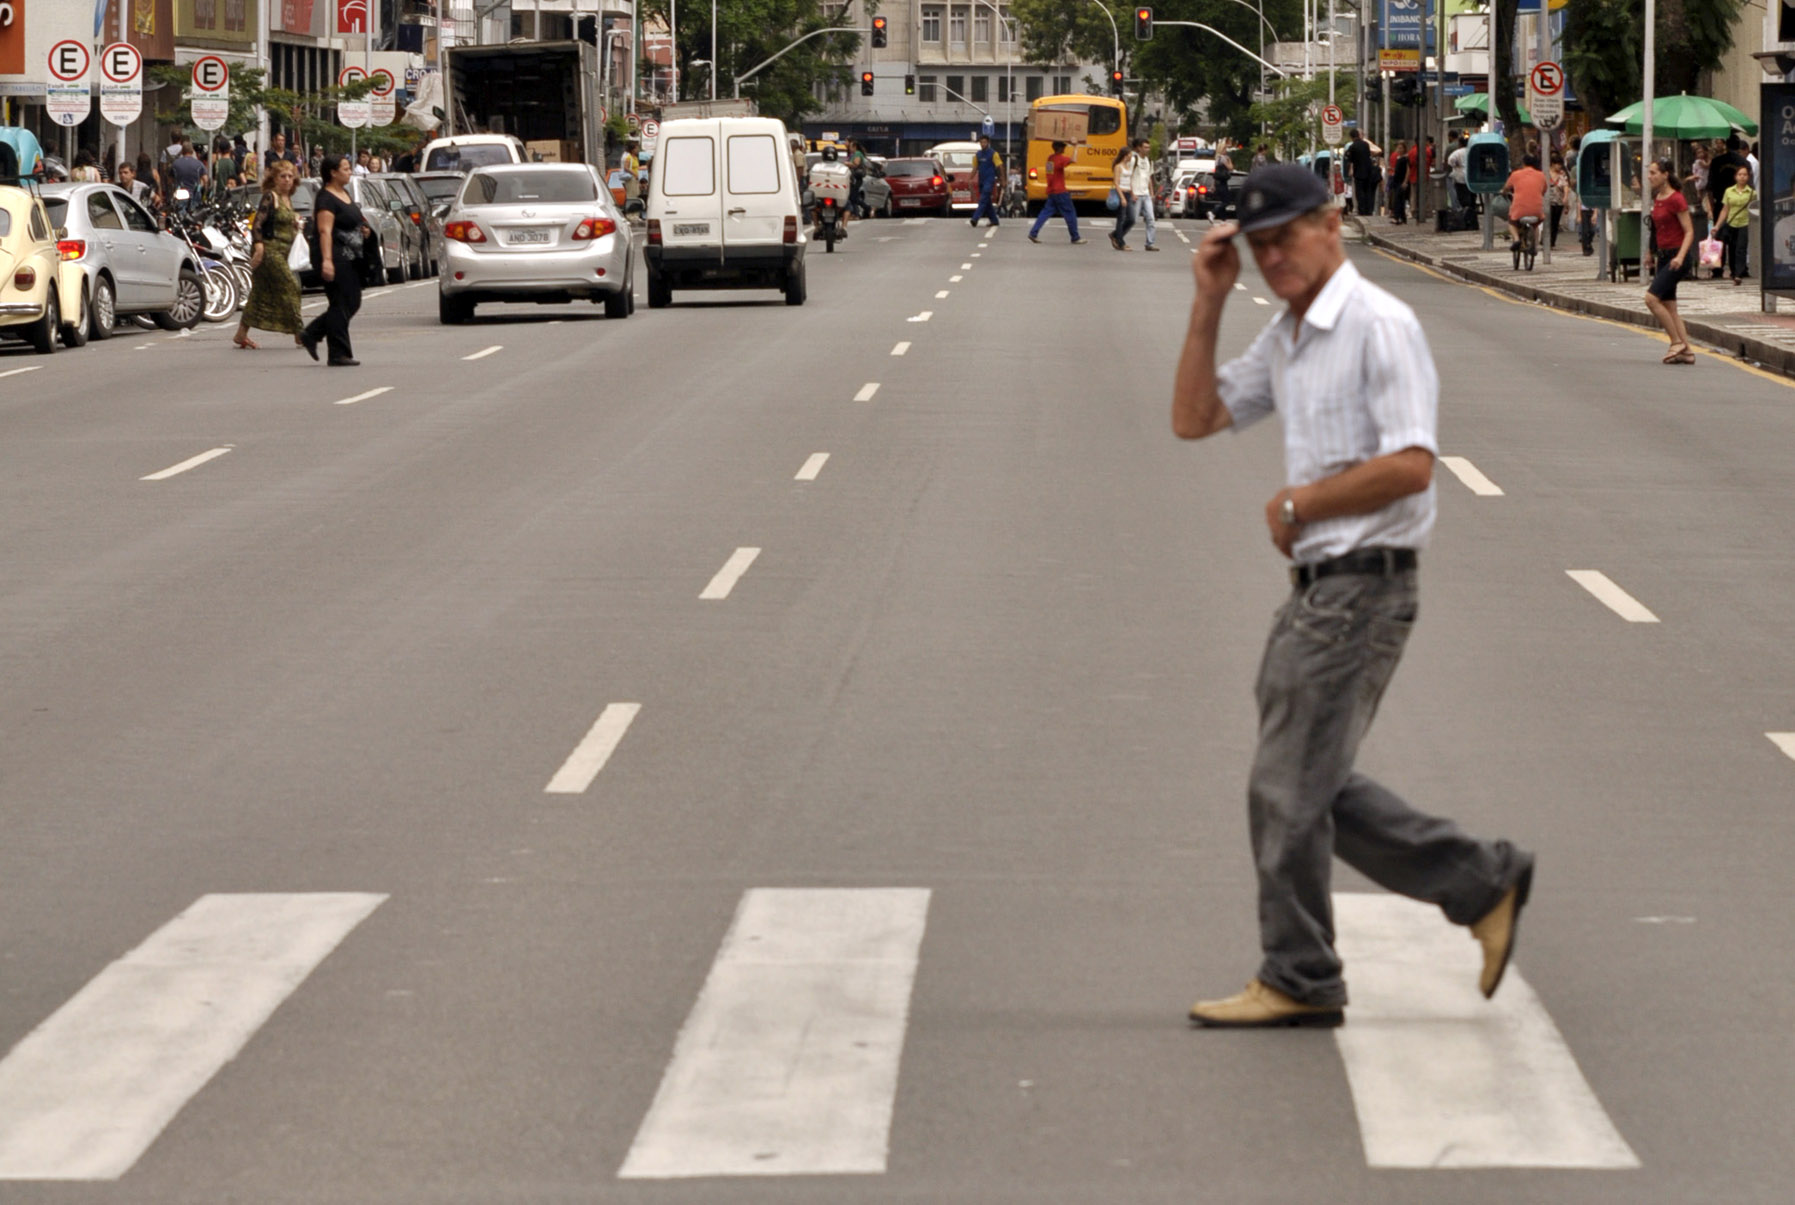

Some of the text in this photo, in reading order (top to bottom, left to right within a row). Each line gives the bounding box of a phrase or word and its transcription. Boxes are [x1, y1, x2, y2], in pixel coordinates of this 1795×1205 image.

[60, 47, 78, 73] E
[113, 51, 130, 75] E
[203, 63, 218, 85] E
[1540, 68, 1554, 89] E
[647, 123, 655, 135] E
[1087, 147, 1118, 156] CN 600
